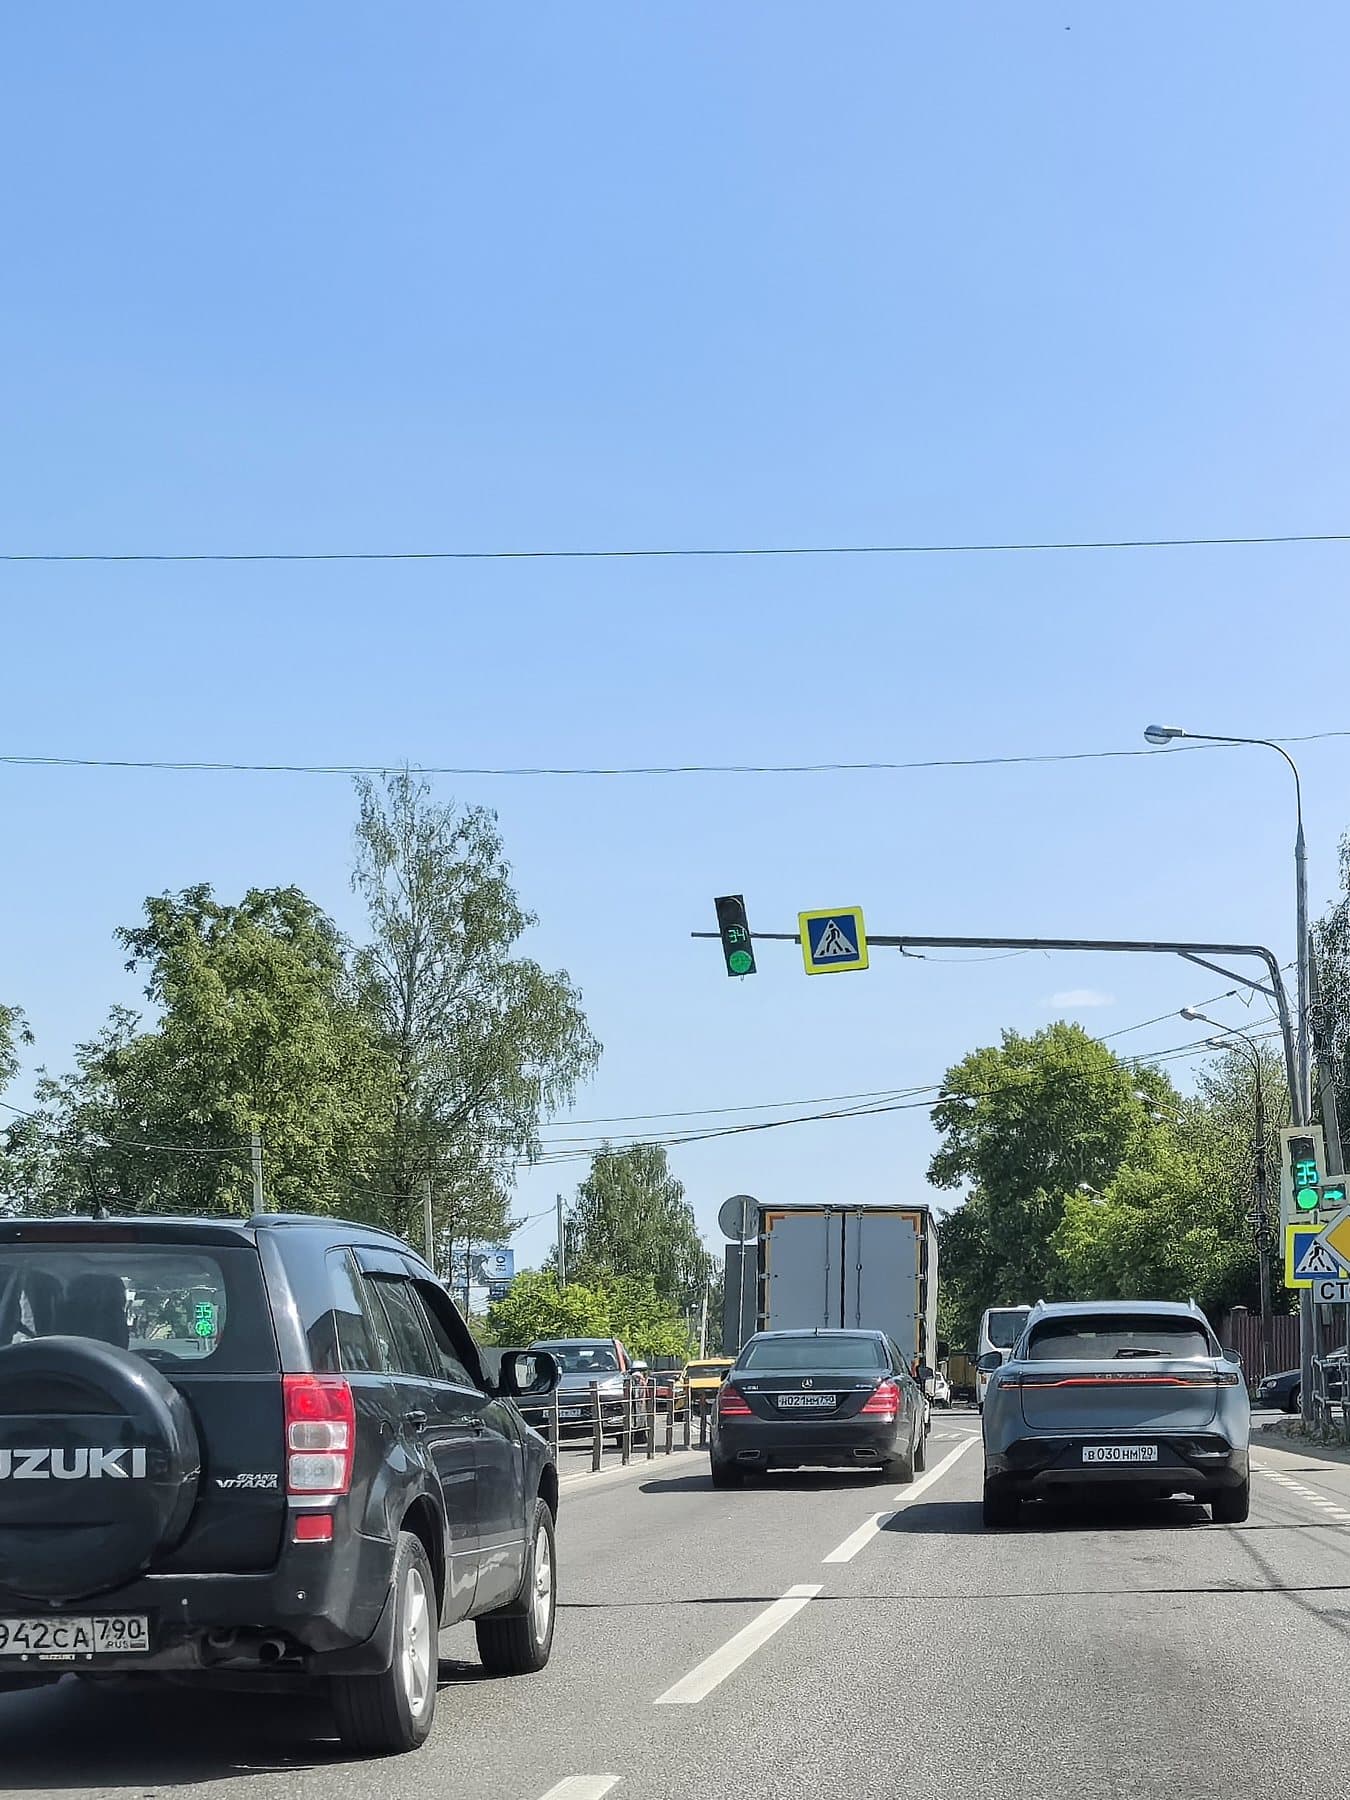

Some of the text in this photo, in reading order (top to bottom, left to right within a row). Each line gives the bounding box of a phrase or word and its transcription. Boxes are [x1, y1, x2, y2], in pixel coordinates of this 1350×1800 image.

[1297, 1161, 1317, 1185] 35
[0, 1448, 146, 1479] ZUKI
[216, 1479, 277, 1488] VITARA
[237, 1473, 278, 1481] GRAND
[95, 1619, 141, 1640] 790
